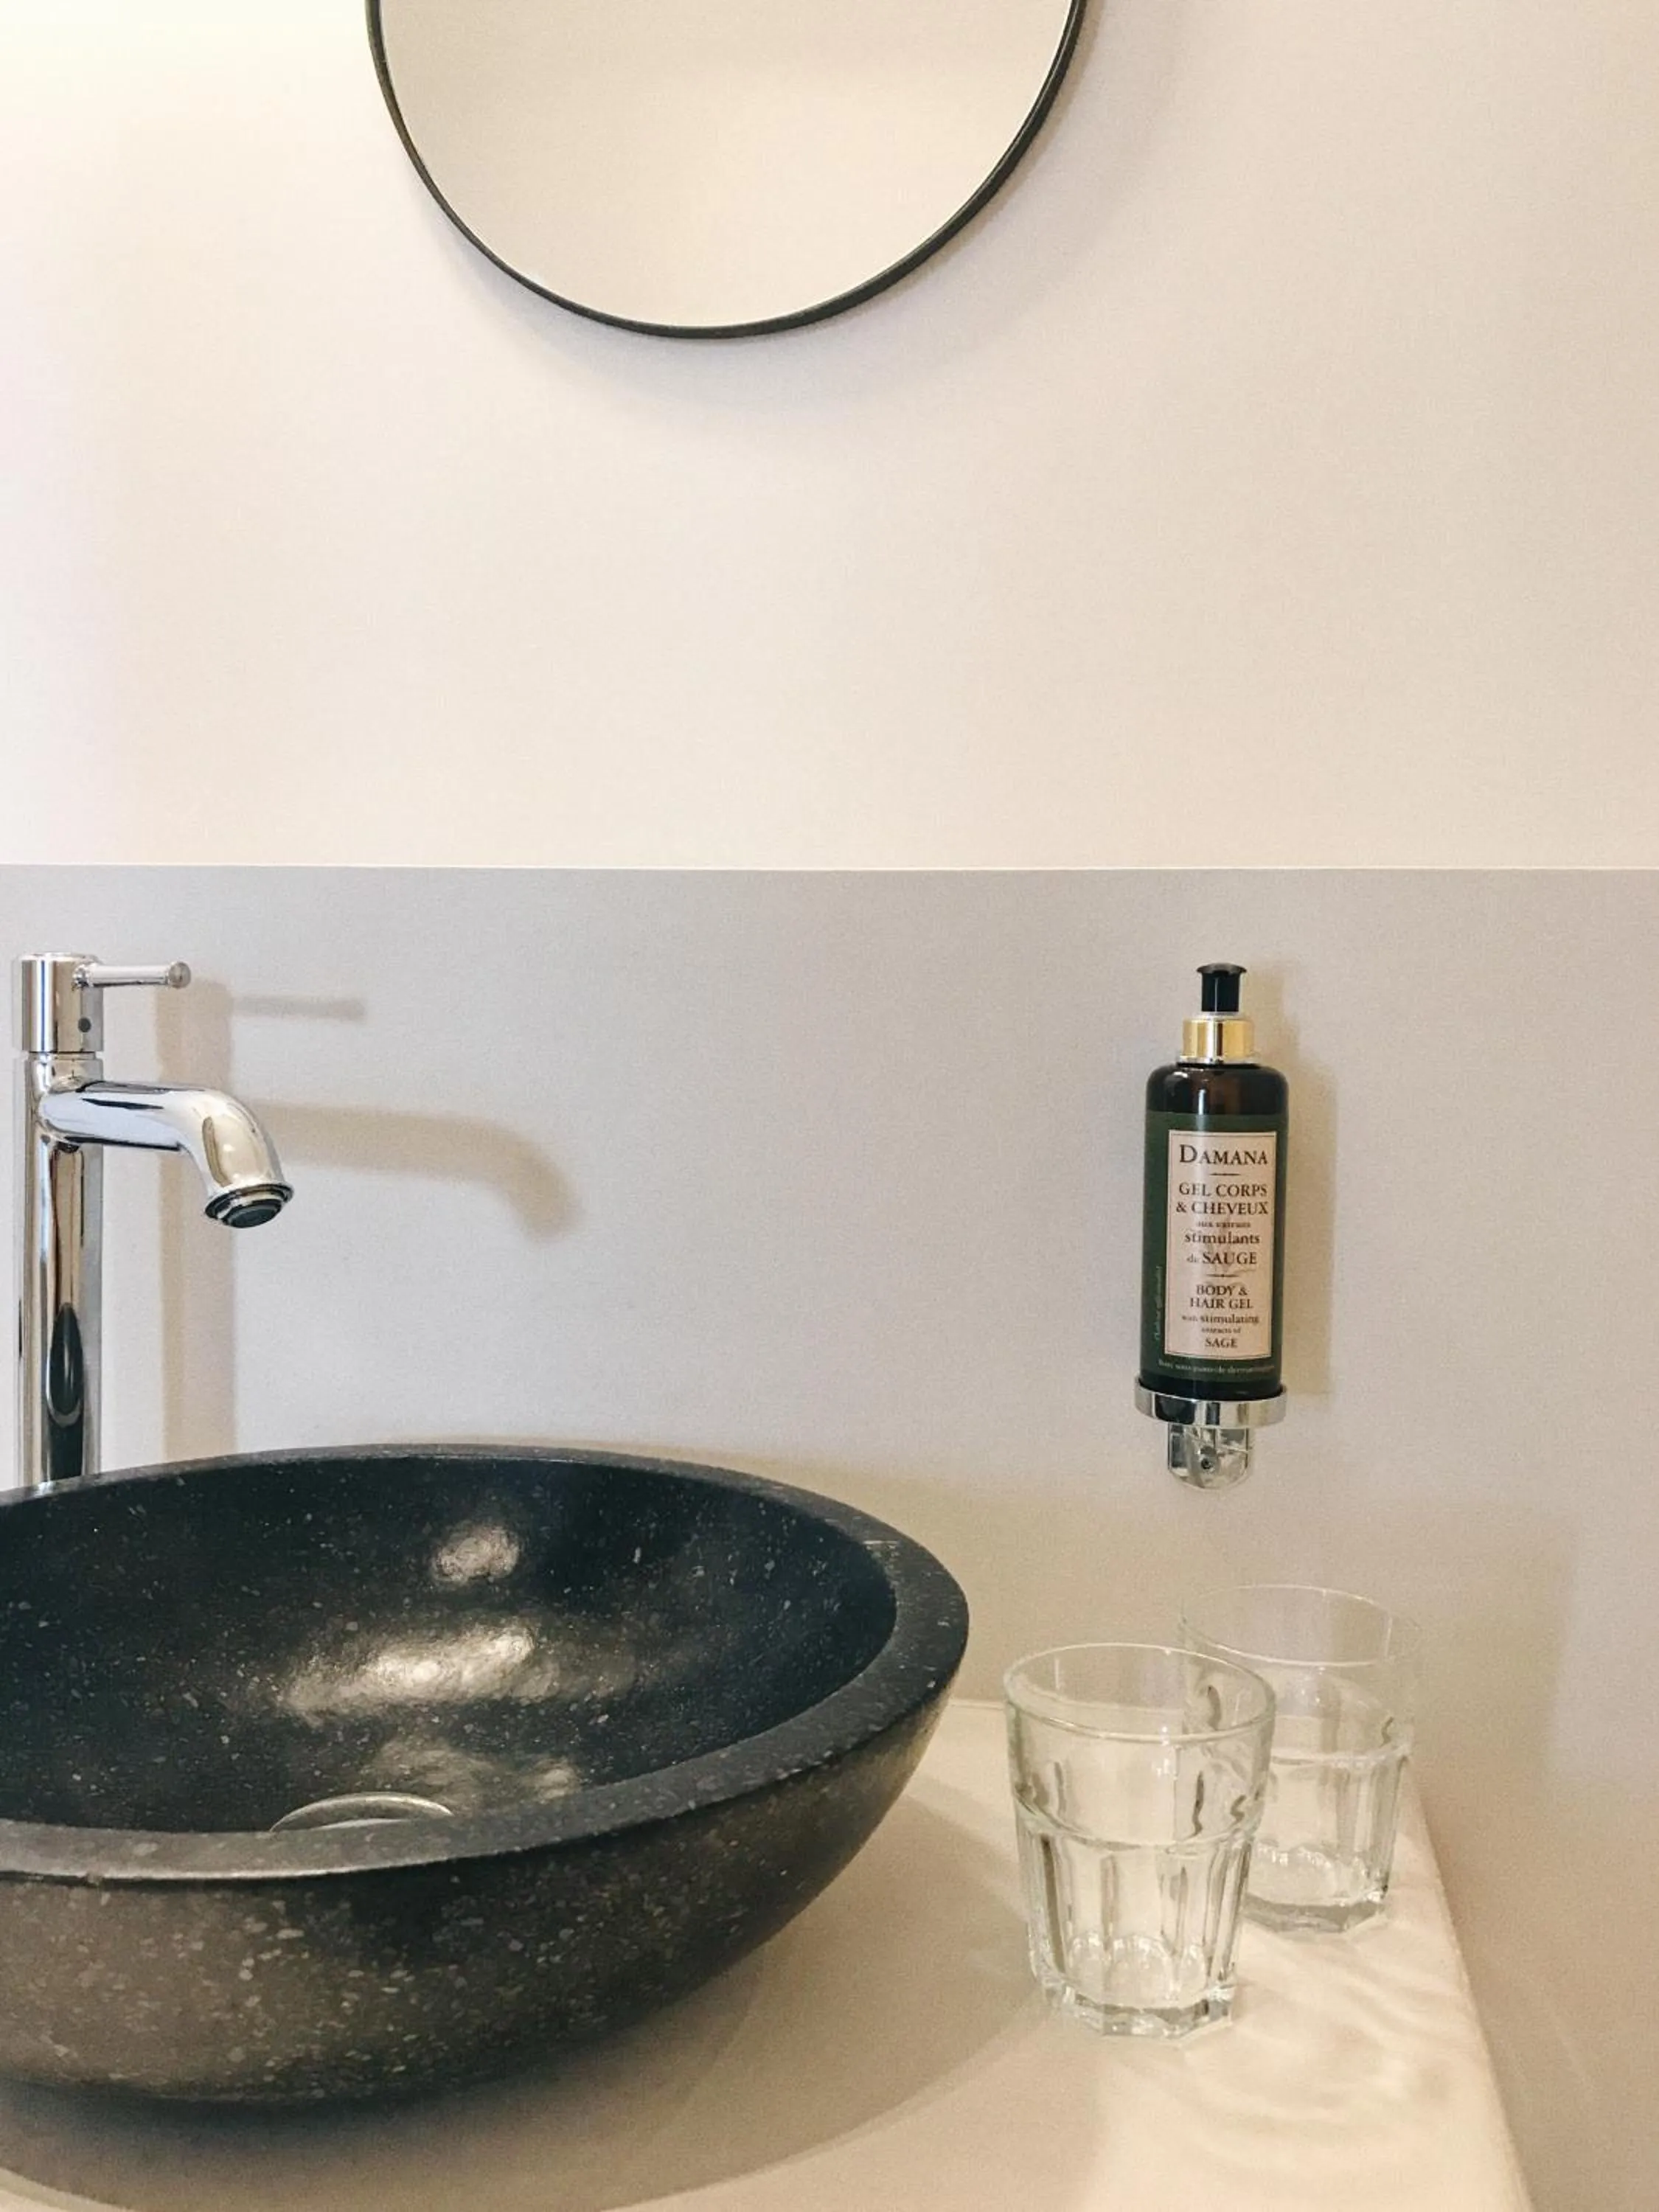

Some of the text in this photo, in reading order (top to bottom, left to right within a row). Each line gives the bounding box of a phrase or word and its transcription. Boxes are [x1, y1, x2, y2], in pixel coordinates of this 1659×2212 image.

[1180, 1144, 1267, 1165] DAMANA
[1179, 1183, 1267, 1197] GEL CORPS
[1176, 1201, 1268, 1214] & CHEVEUX
[1185, 1231, 1260, 1245] stimulants
[1203, 1251, 1257, 1265] SAUGE
[1196, 1284, 1248, 1295] BODY &
[1190, 1297, 1253, 1309] HAIR GEL
[1205, 1337, 1238, 1348] SAGE
